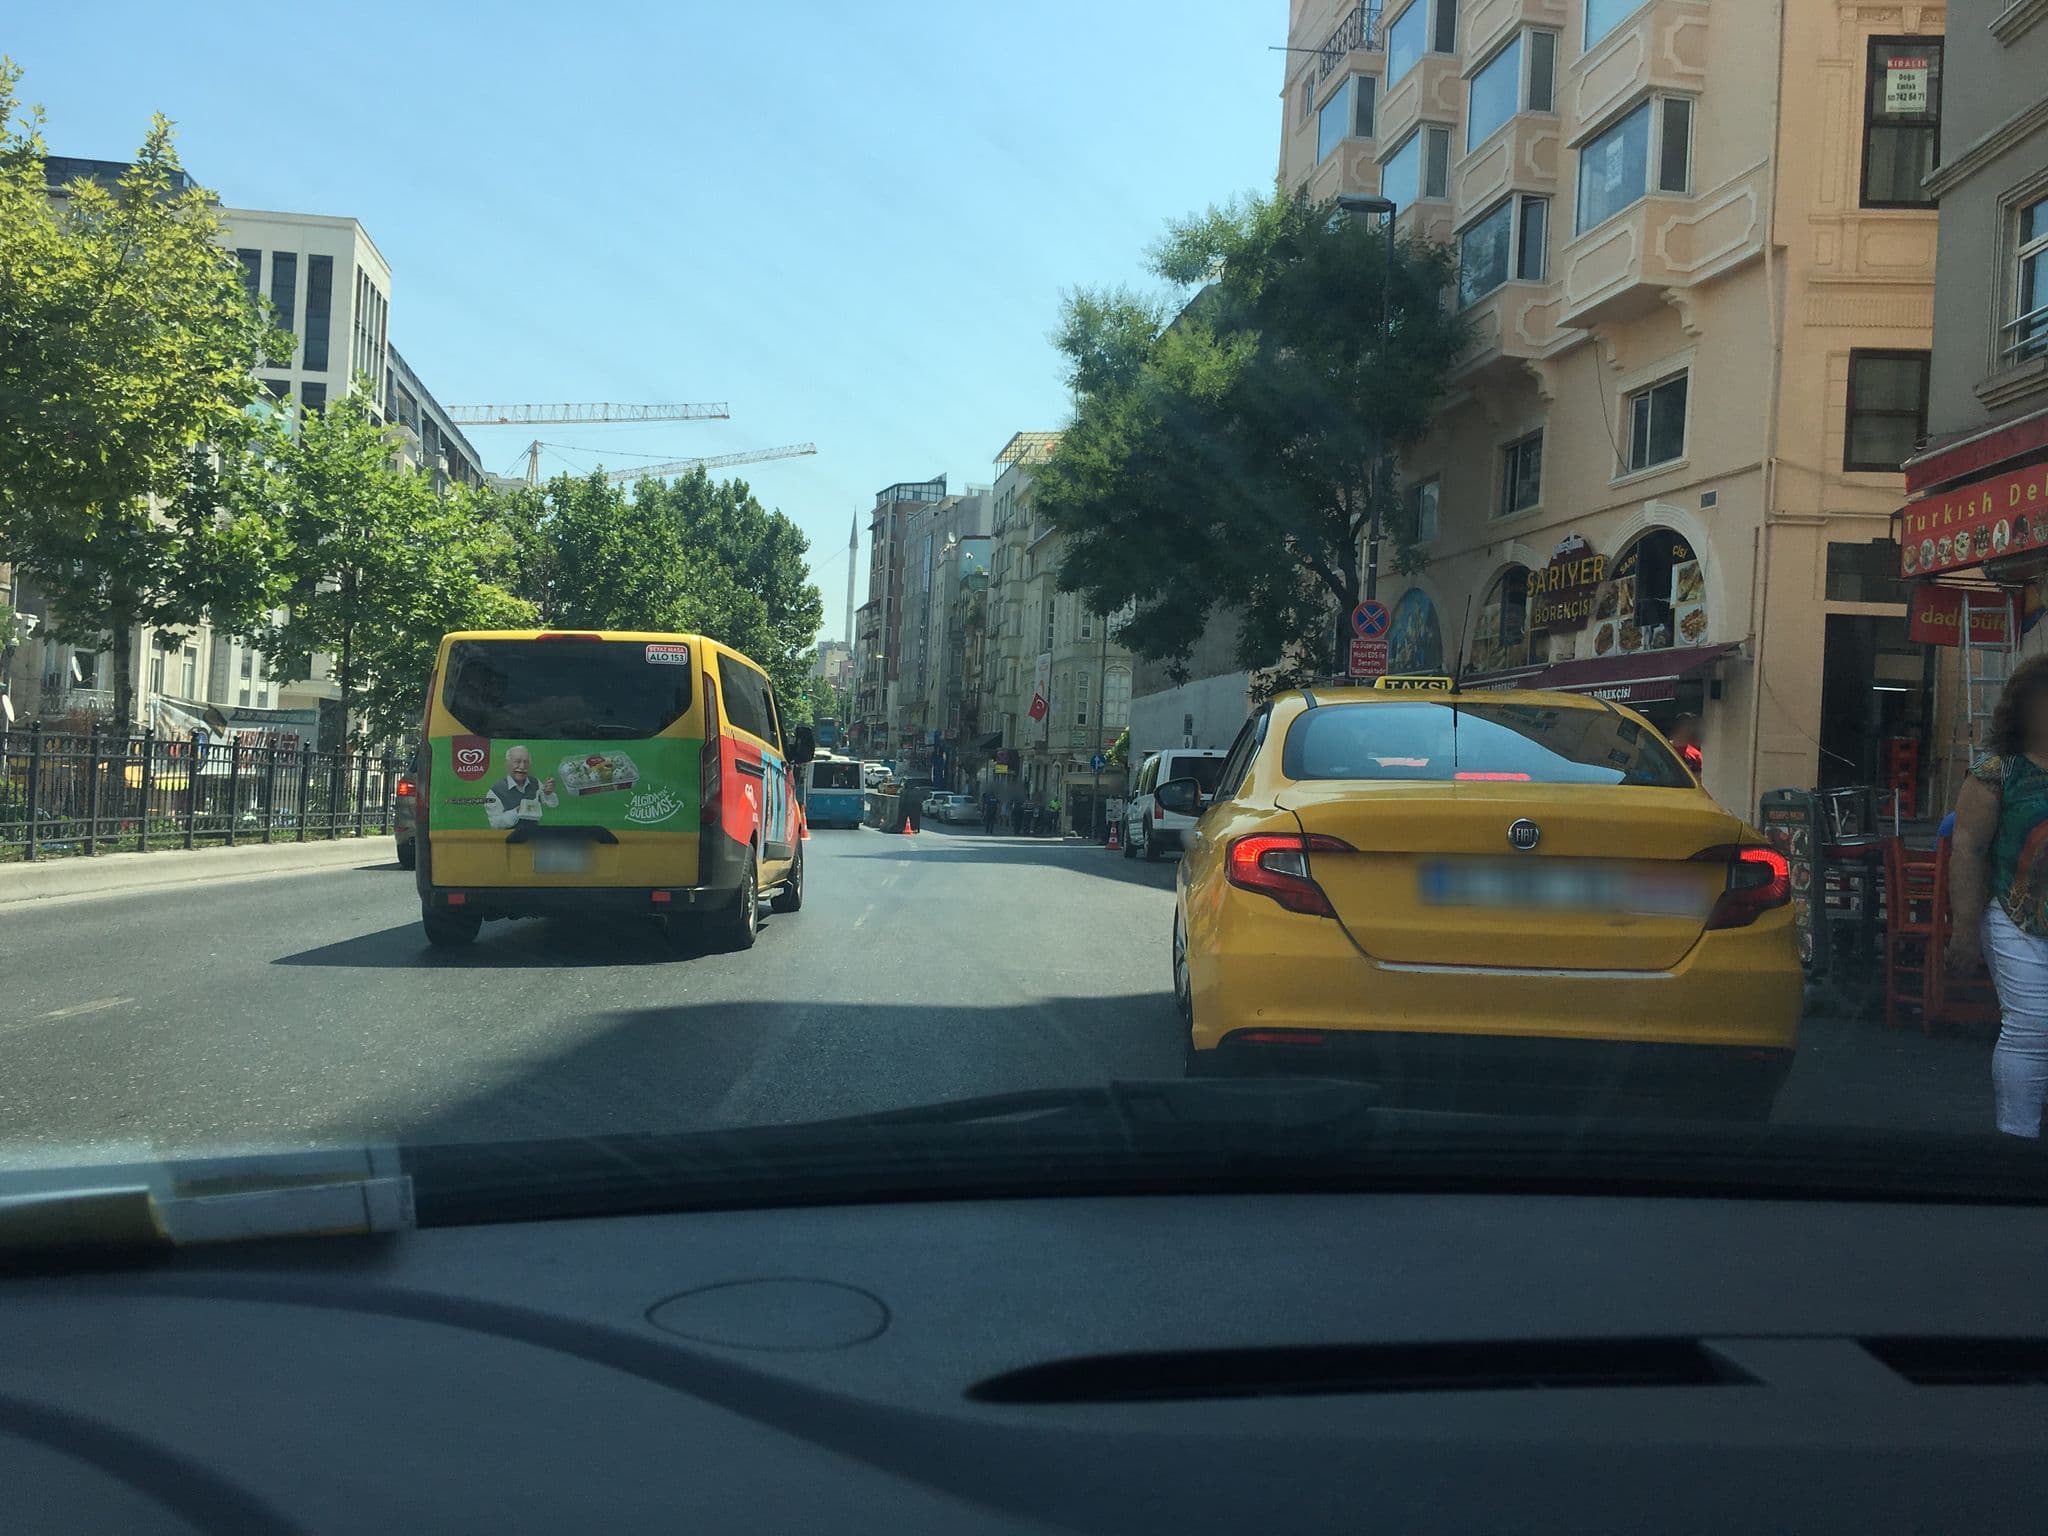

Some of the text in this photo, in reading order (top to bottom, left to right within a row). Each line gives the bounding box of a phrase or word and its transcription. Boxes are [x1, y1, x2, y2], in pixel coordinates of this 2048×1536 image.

[1906, 490, 1993, 535] Turkish
[1526, 552, 1606, 598] SARIYER
[650, 653, 684, 662] ALO 153
[630, 795, 677, 819] GÜLÜMSE
[1516, 828, 1535, 842] FIAT
